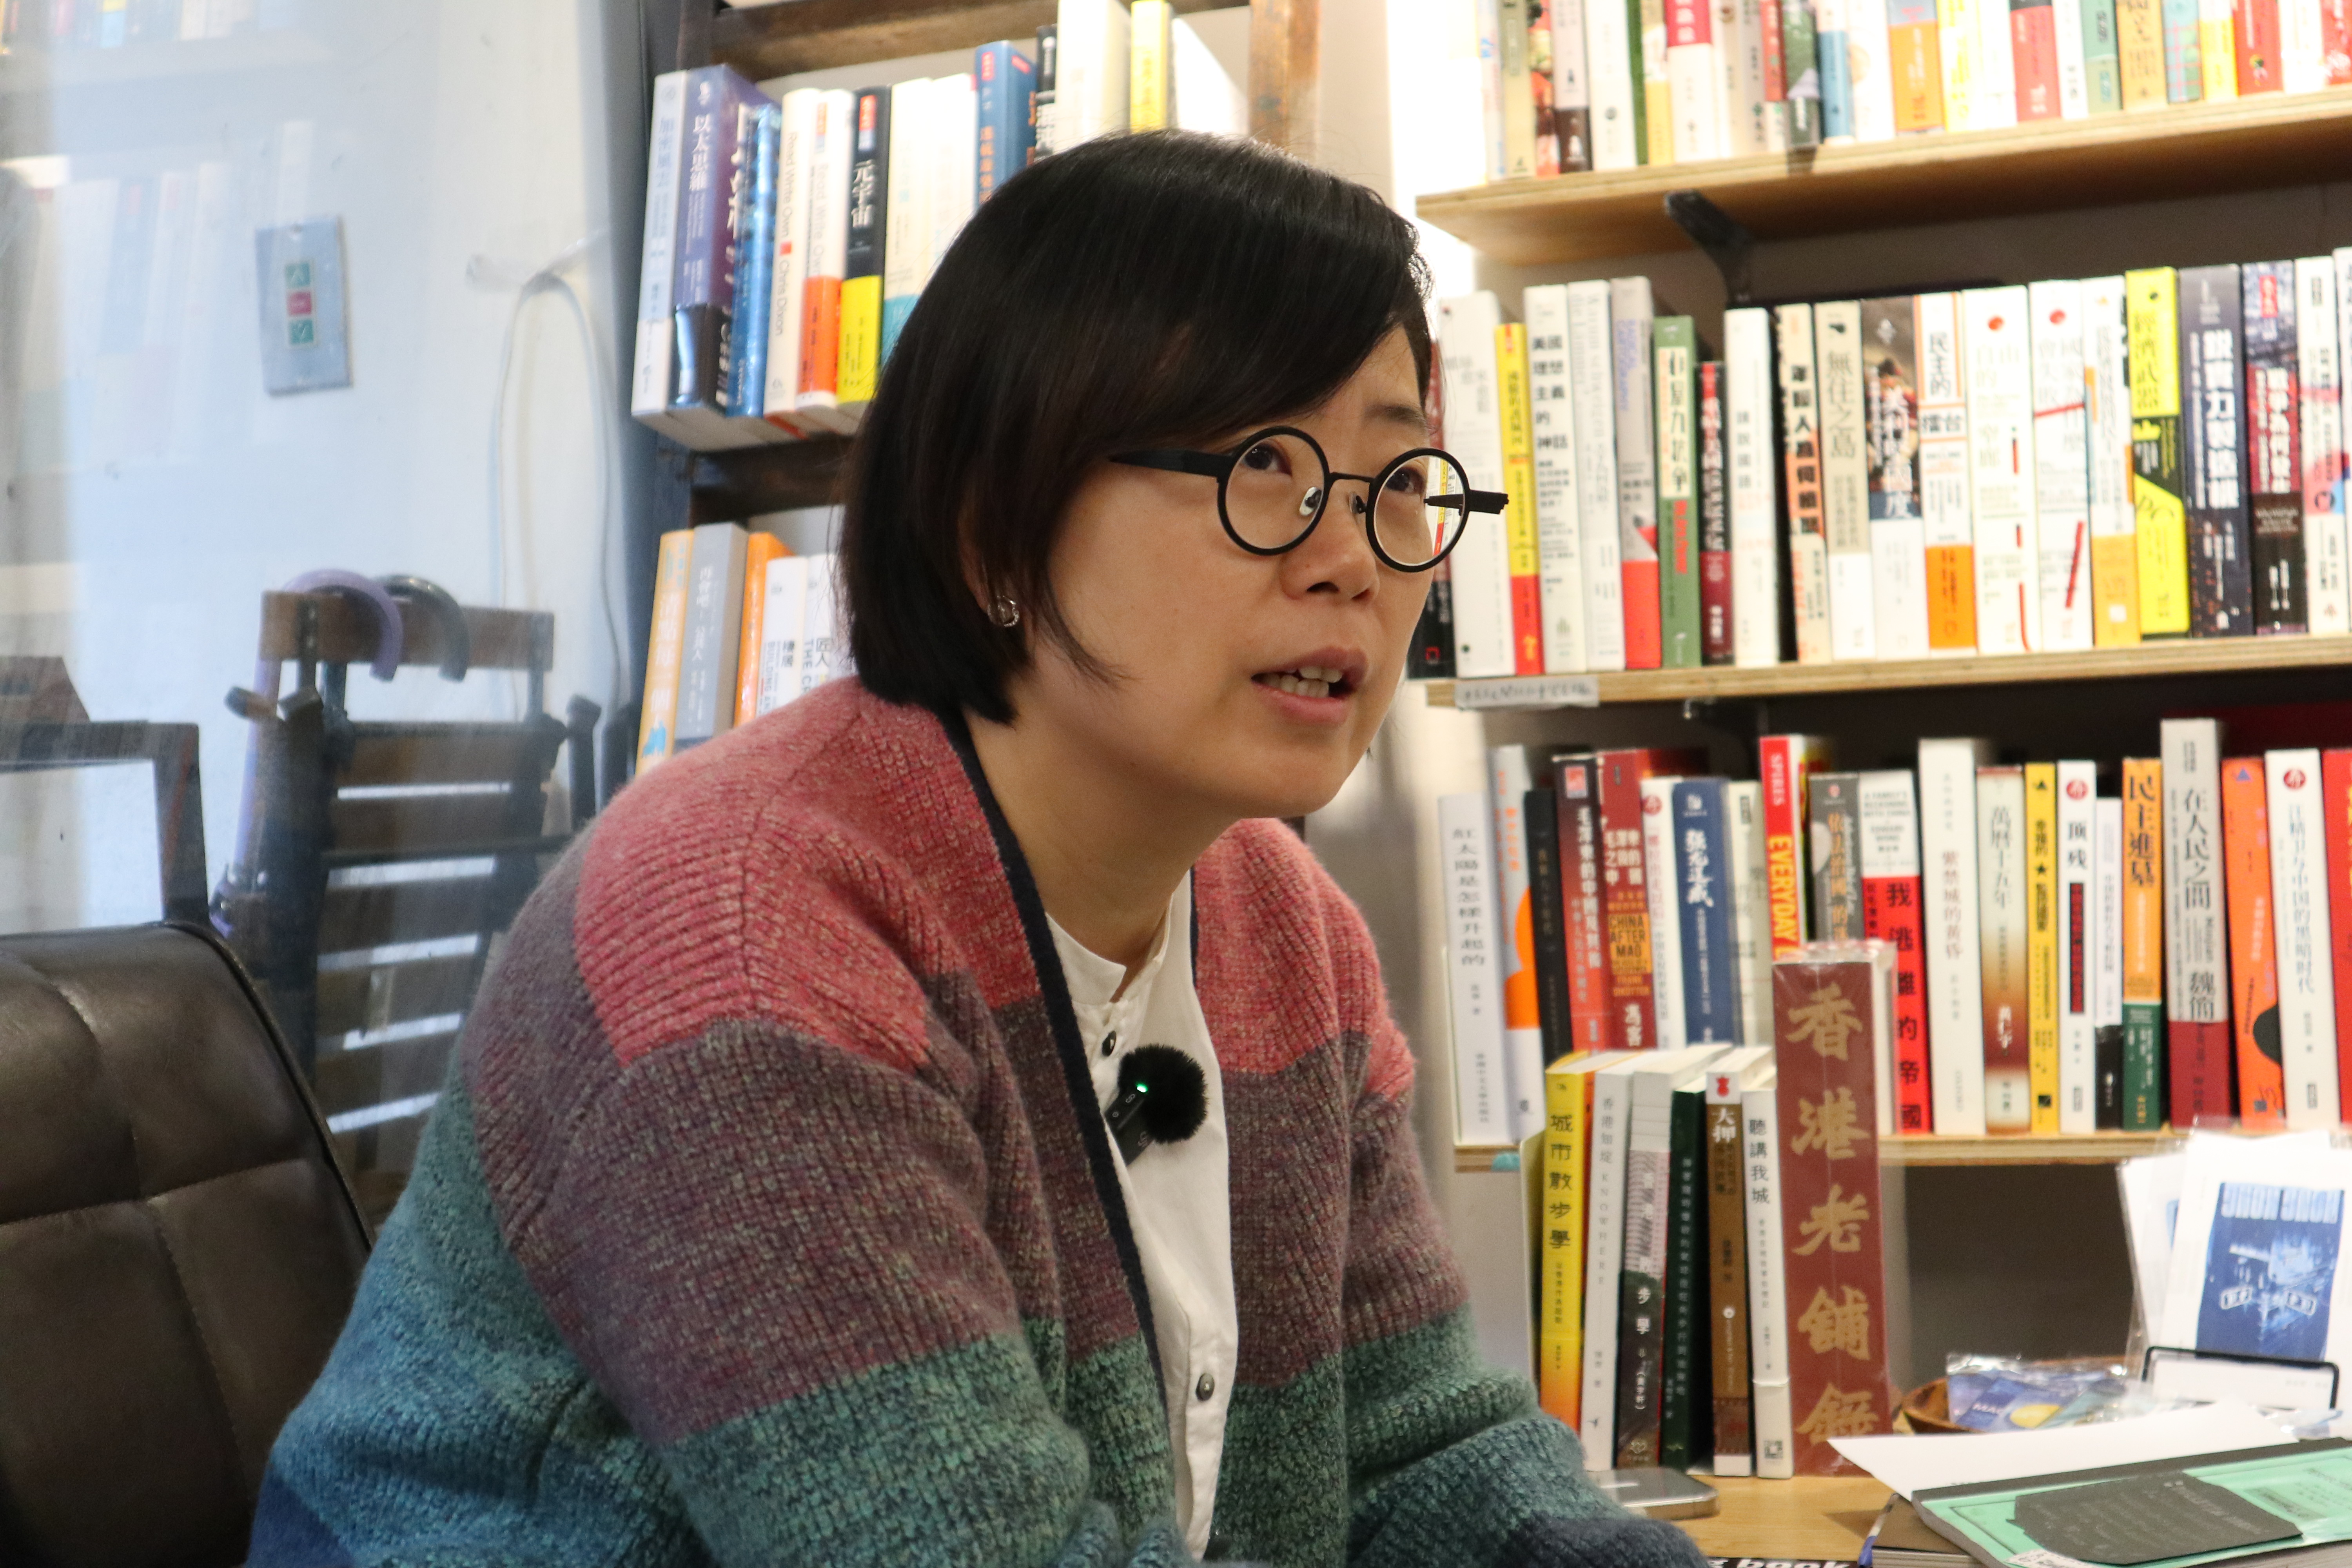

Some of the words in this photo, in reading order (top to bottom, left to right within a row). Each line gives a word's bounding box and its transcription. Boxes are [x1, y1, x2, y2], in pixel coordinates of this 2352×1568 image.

[851, 160, 876, 229] 元宇宙
[1532, 335, 1563, 350] 美國
[1532, 360, 1563, 376] 理想
[1930, 332, 1951, 397] 民主的
[1535, 385, 1565, 400] 主義
[1828, 351, 1855, 458] 無住之島
[1535, 411, 1550, 425] 的
[1921, 413, 1961, 432] 擂台
[1537, 434, 1568, 450] 神話
[765, 641, 776, 691] BUILDING
[803, 639, 814, 669] THE
[816, 638, 833, 668] 匠人
[2184, 788, 2211, 910] 在人民之間
[1452, 827, 1485, 966] 紅太陽是怎樣升起的
[1768, 835, 1800, 942] EVERYDAY
[1942, 850, 1963, 959] 紫禁城的黃昏
[1609, 915, 1643, 929] CHINA
[1610, 929, 1646, 943] AFTER
[1615, 943, 1642, 958] MAO
[1886, 882, 1922, 1129] 我逃離的帝國
[1711, 1108, 1737, 1143] 大押
[1548, 1113, 1574, 1249] 城市散步學
[1748, 1118, 1770, 1205] 聽講我城
[1598, 1173, 1608, 1285] KNOWHERE
